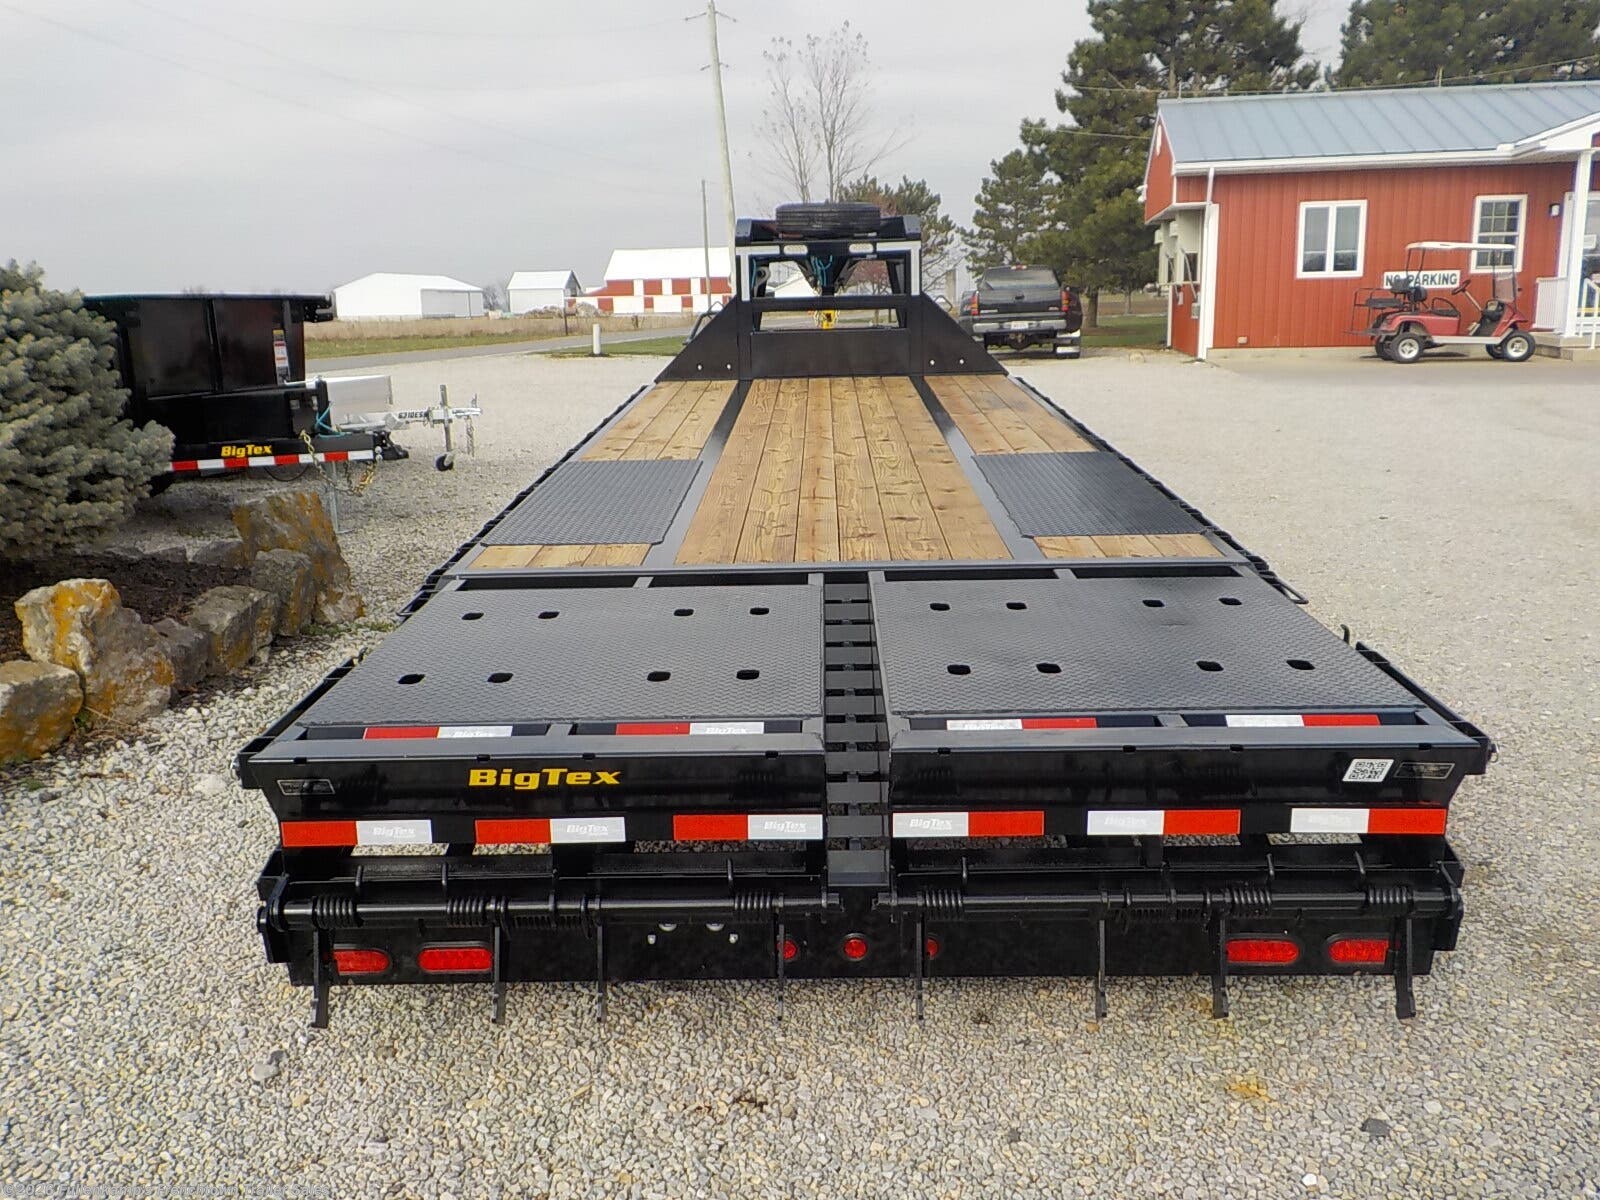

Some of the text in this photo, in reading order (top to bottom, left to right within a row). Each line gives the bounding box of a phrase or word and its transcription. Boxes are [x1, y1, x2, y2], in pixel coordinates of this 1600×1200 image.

[1407, 273, 1457, 286] PARKING
[221, 444, 272, 458] BigTex
[469, 768, 621, 790] BigTex
[764, 821, 807, 832] BigTex
[909, 818, 953, 829] BigTex
[372, 826, 415, 836] BigTex
[566, 824, 609, 835] BigTex
